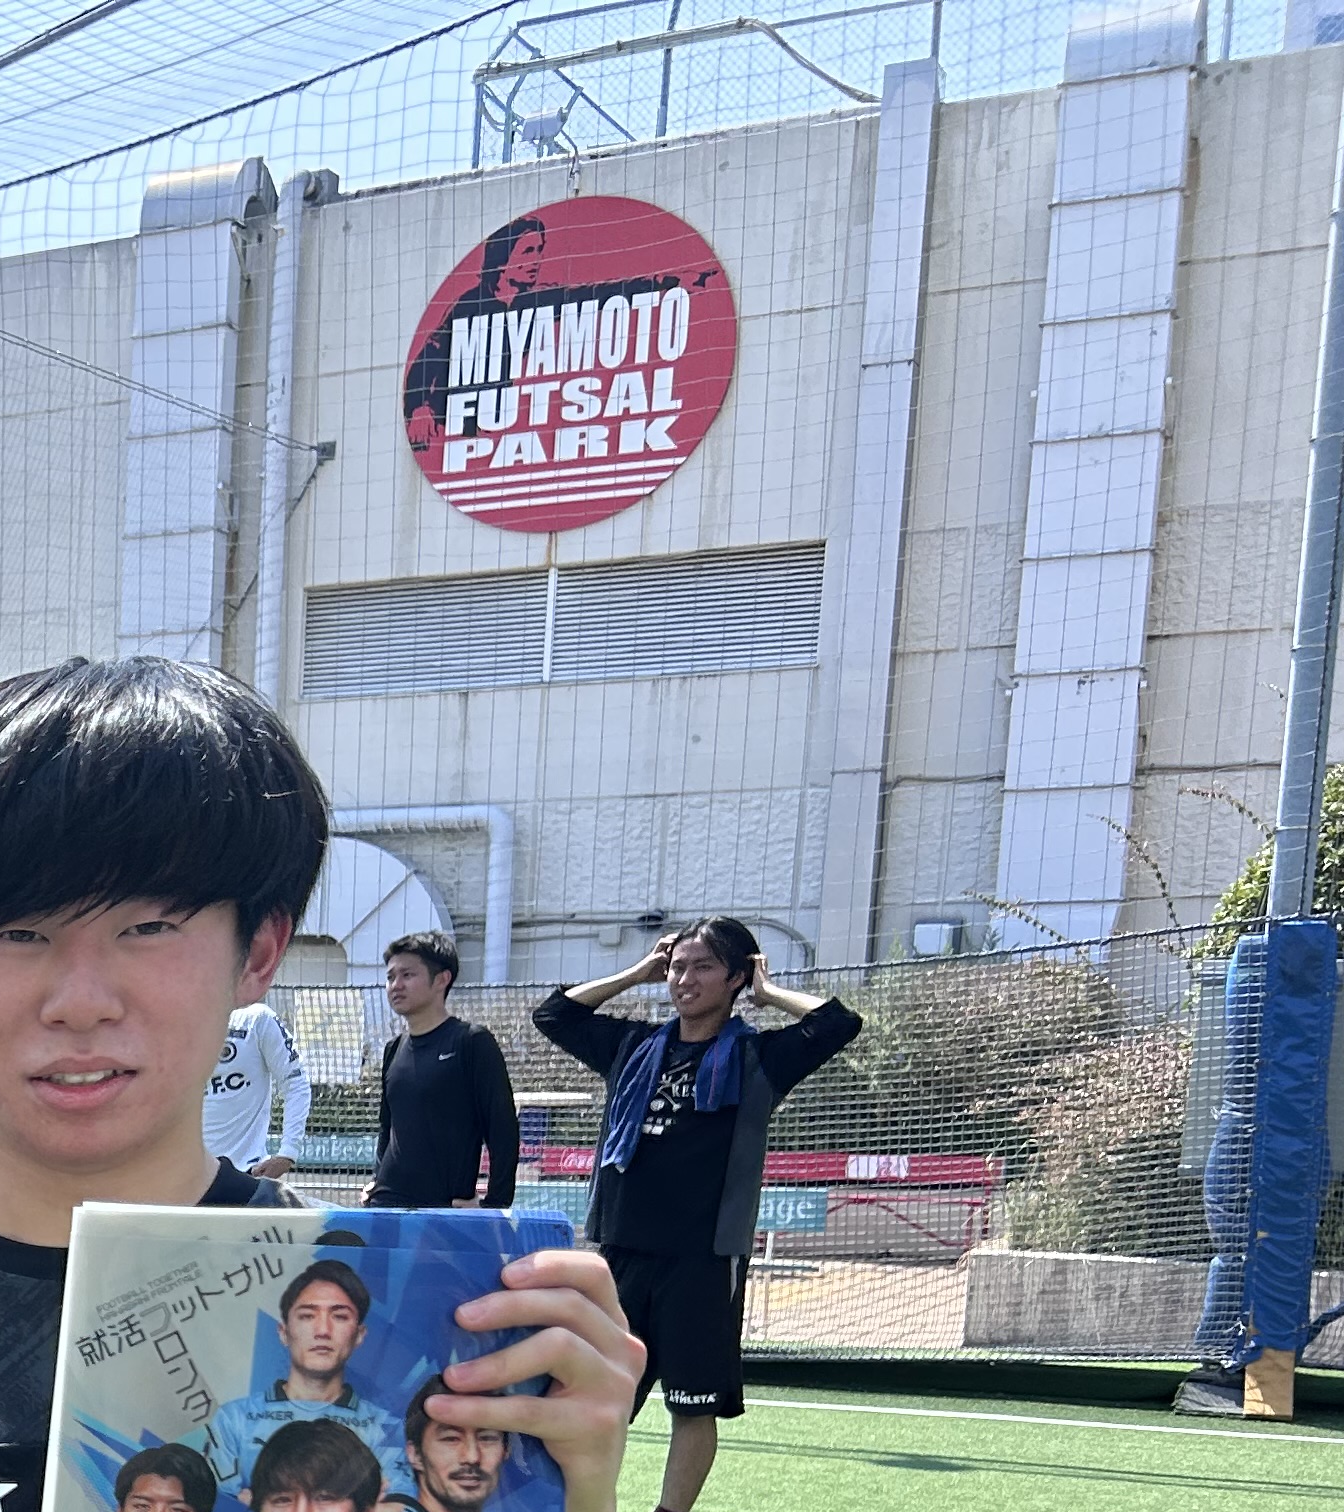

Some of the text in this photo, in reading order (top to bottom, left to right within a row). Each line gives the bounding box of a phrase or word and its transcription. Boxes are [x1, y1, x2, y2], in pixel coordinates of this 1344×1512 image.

[449, 287, 691, 388] MIYAMOTO
[445, 367, 683, 437] FUTSAL
[442, 414, 679, 474] PARK
